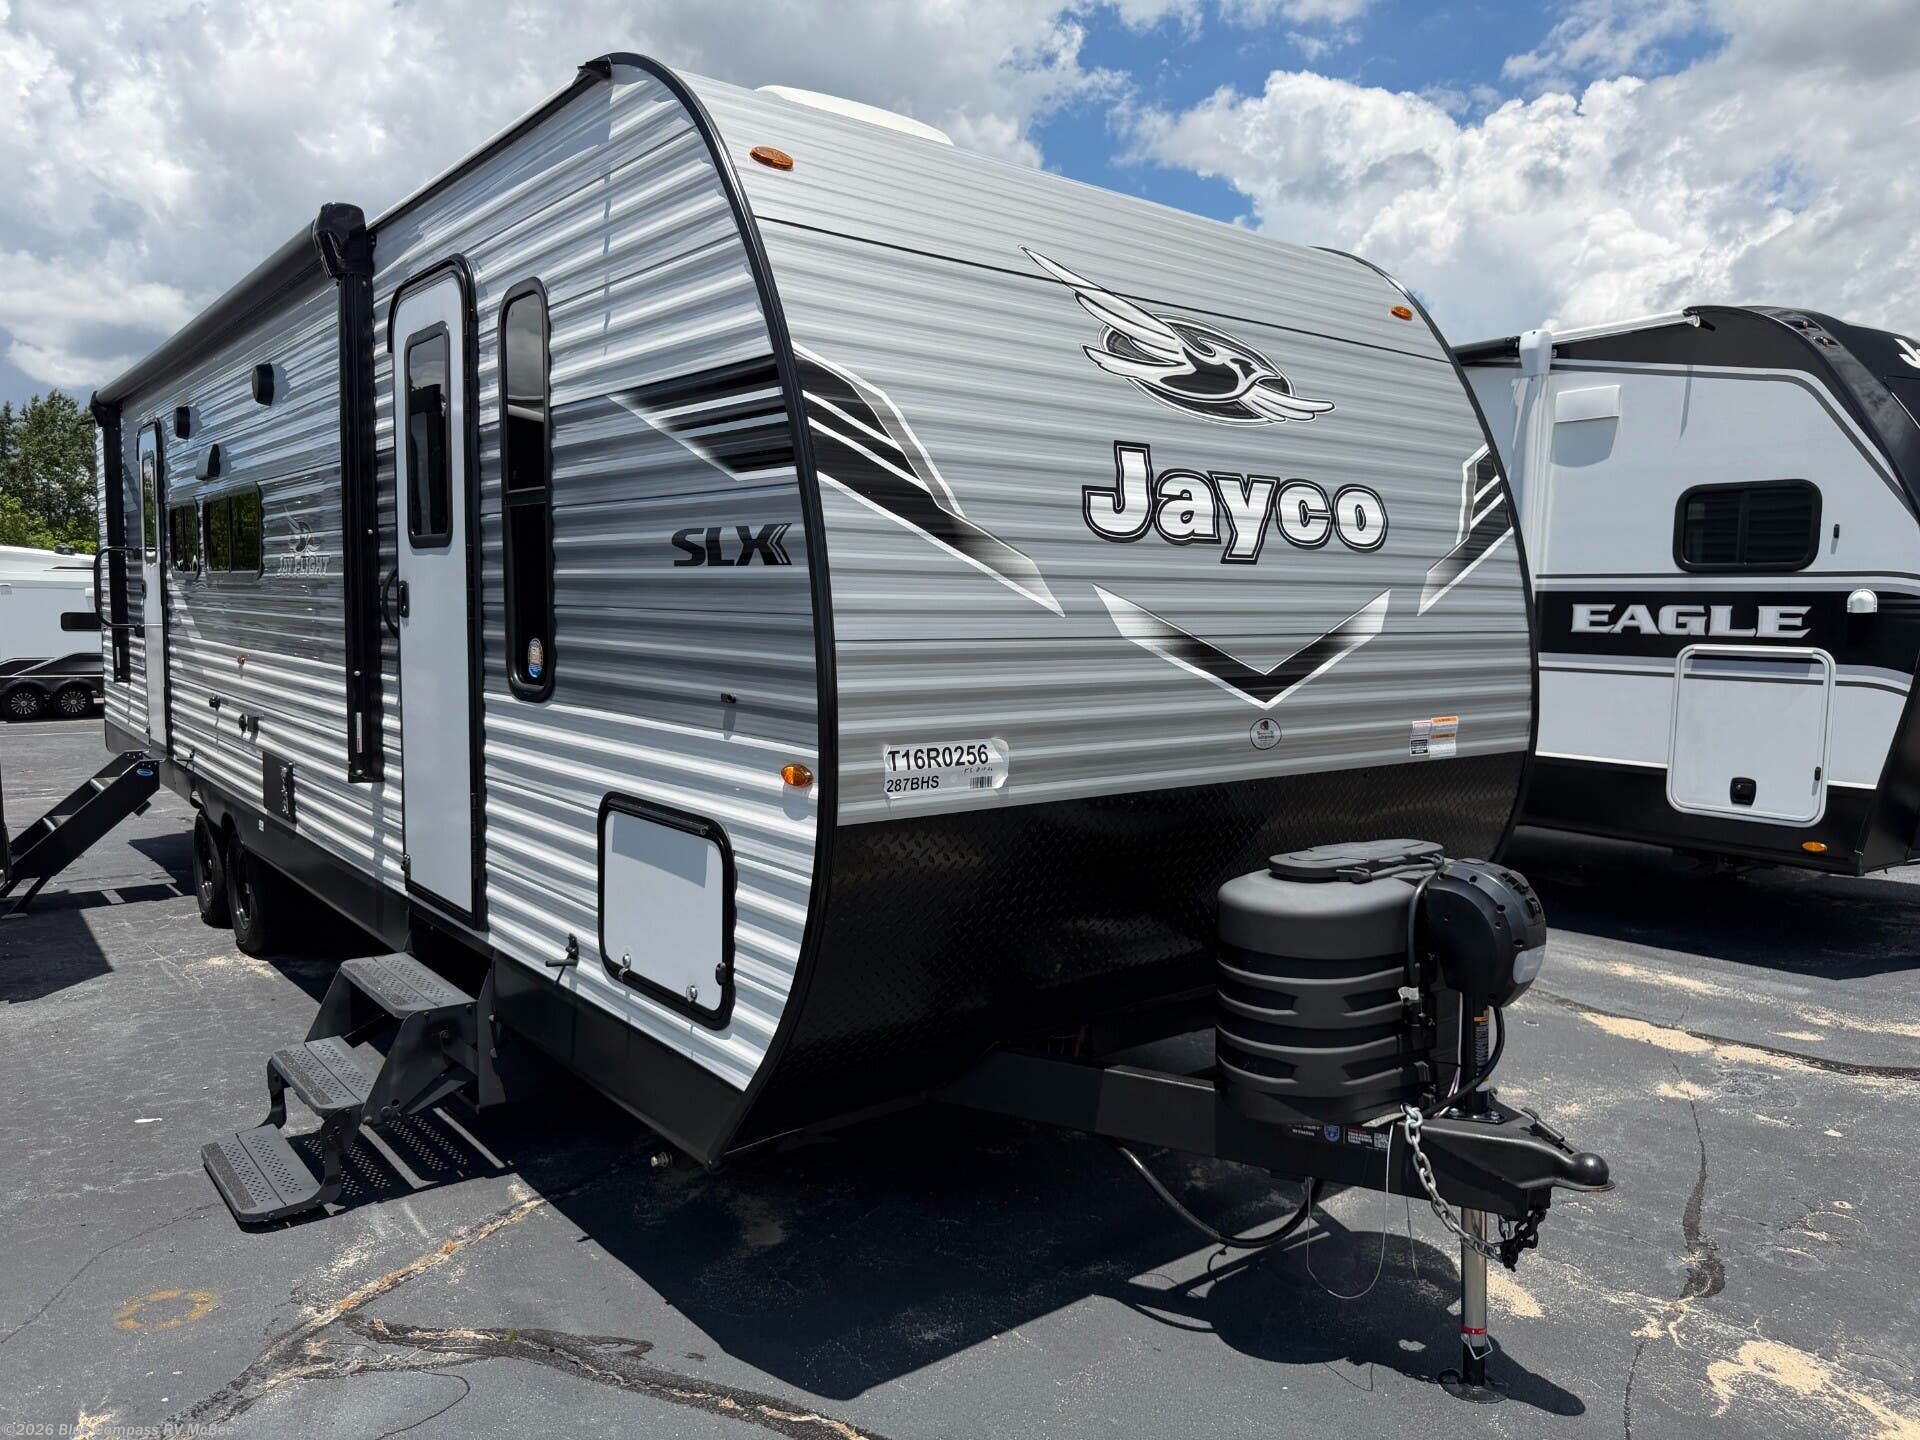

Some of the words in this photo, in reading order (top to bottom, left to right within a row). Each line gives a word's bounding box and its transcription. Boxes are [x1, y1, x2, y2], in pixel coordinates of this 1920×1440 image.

[1082, 440, 1388, 565] Jayco
[671, 523, 793, 567] SLX
[295, 552, 332, 576] FLIGHT
[1571, 603, 1812, 638] EAGLE
[887, 744, 989, 772] T16R0256
[886, 775, 940, 793] 287BHS
